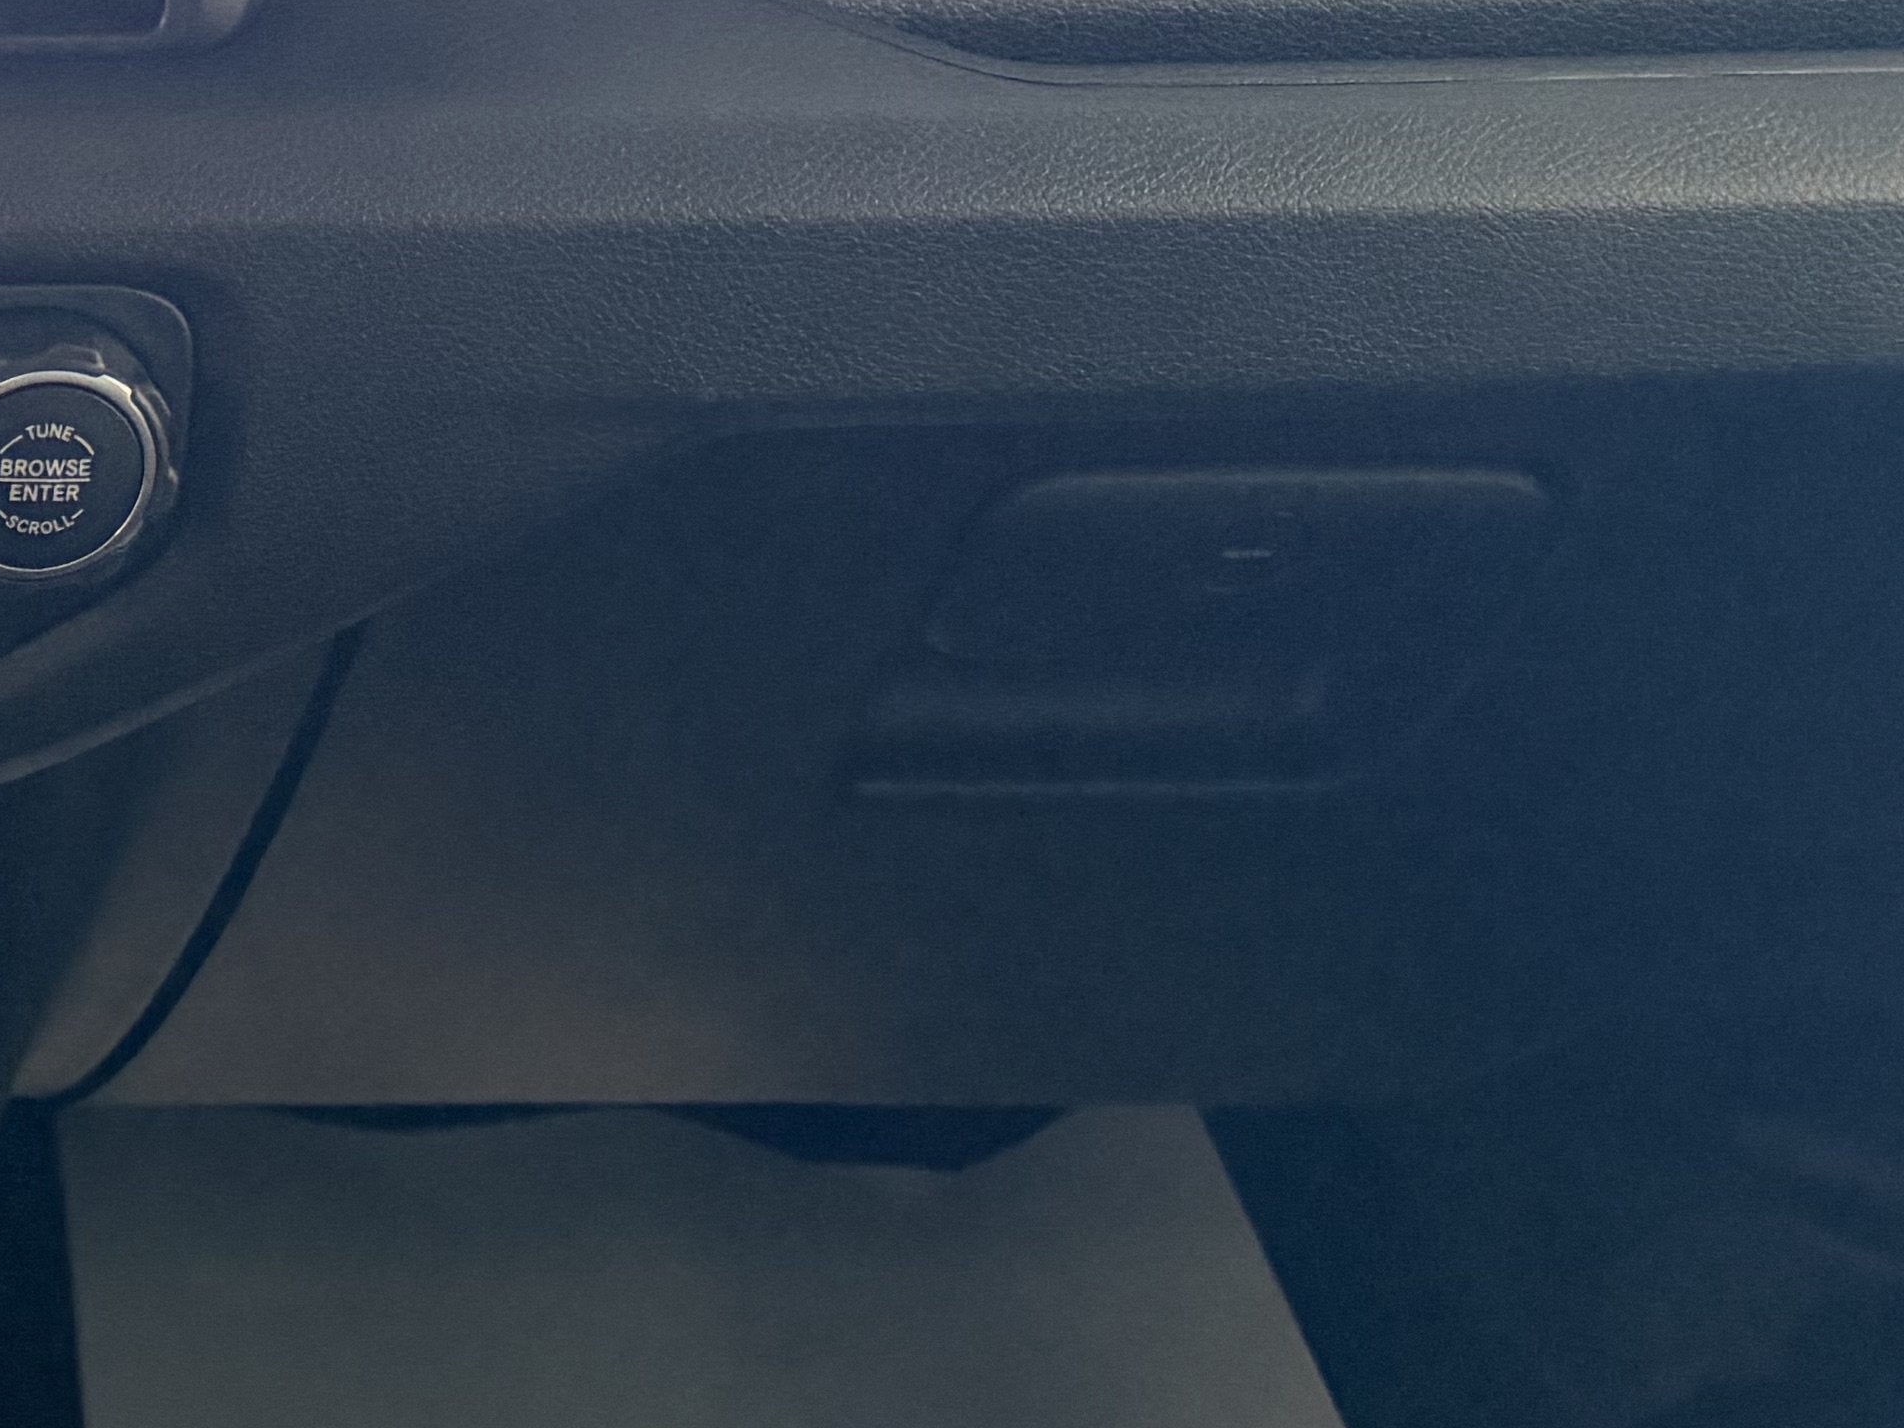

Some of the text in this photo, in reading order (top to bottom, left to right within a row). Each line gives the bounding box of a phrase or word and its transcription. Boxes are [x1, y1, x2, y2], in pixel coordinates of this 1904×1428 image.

[23, 423, 76, 444] TUNE
[7, 484, 80, 504] ENTER
[3, 512, 77, 537] SCROLL
